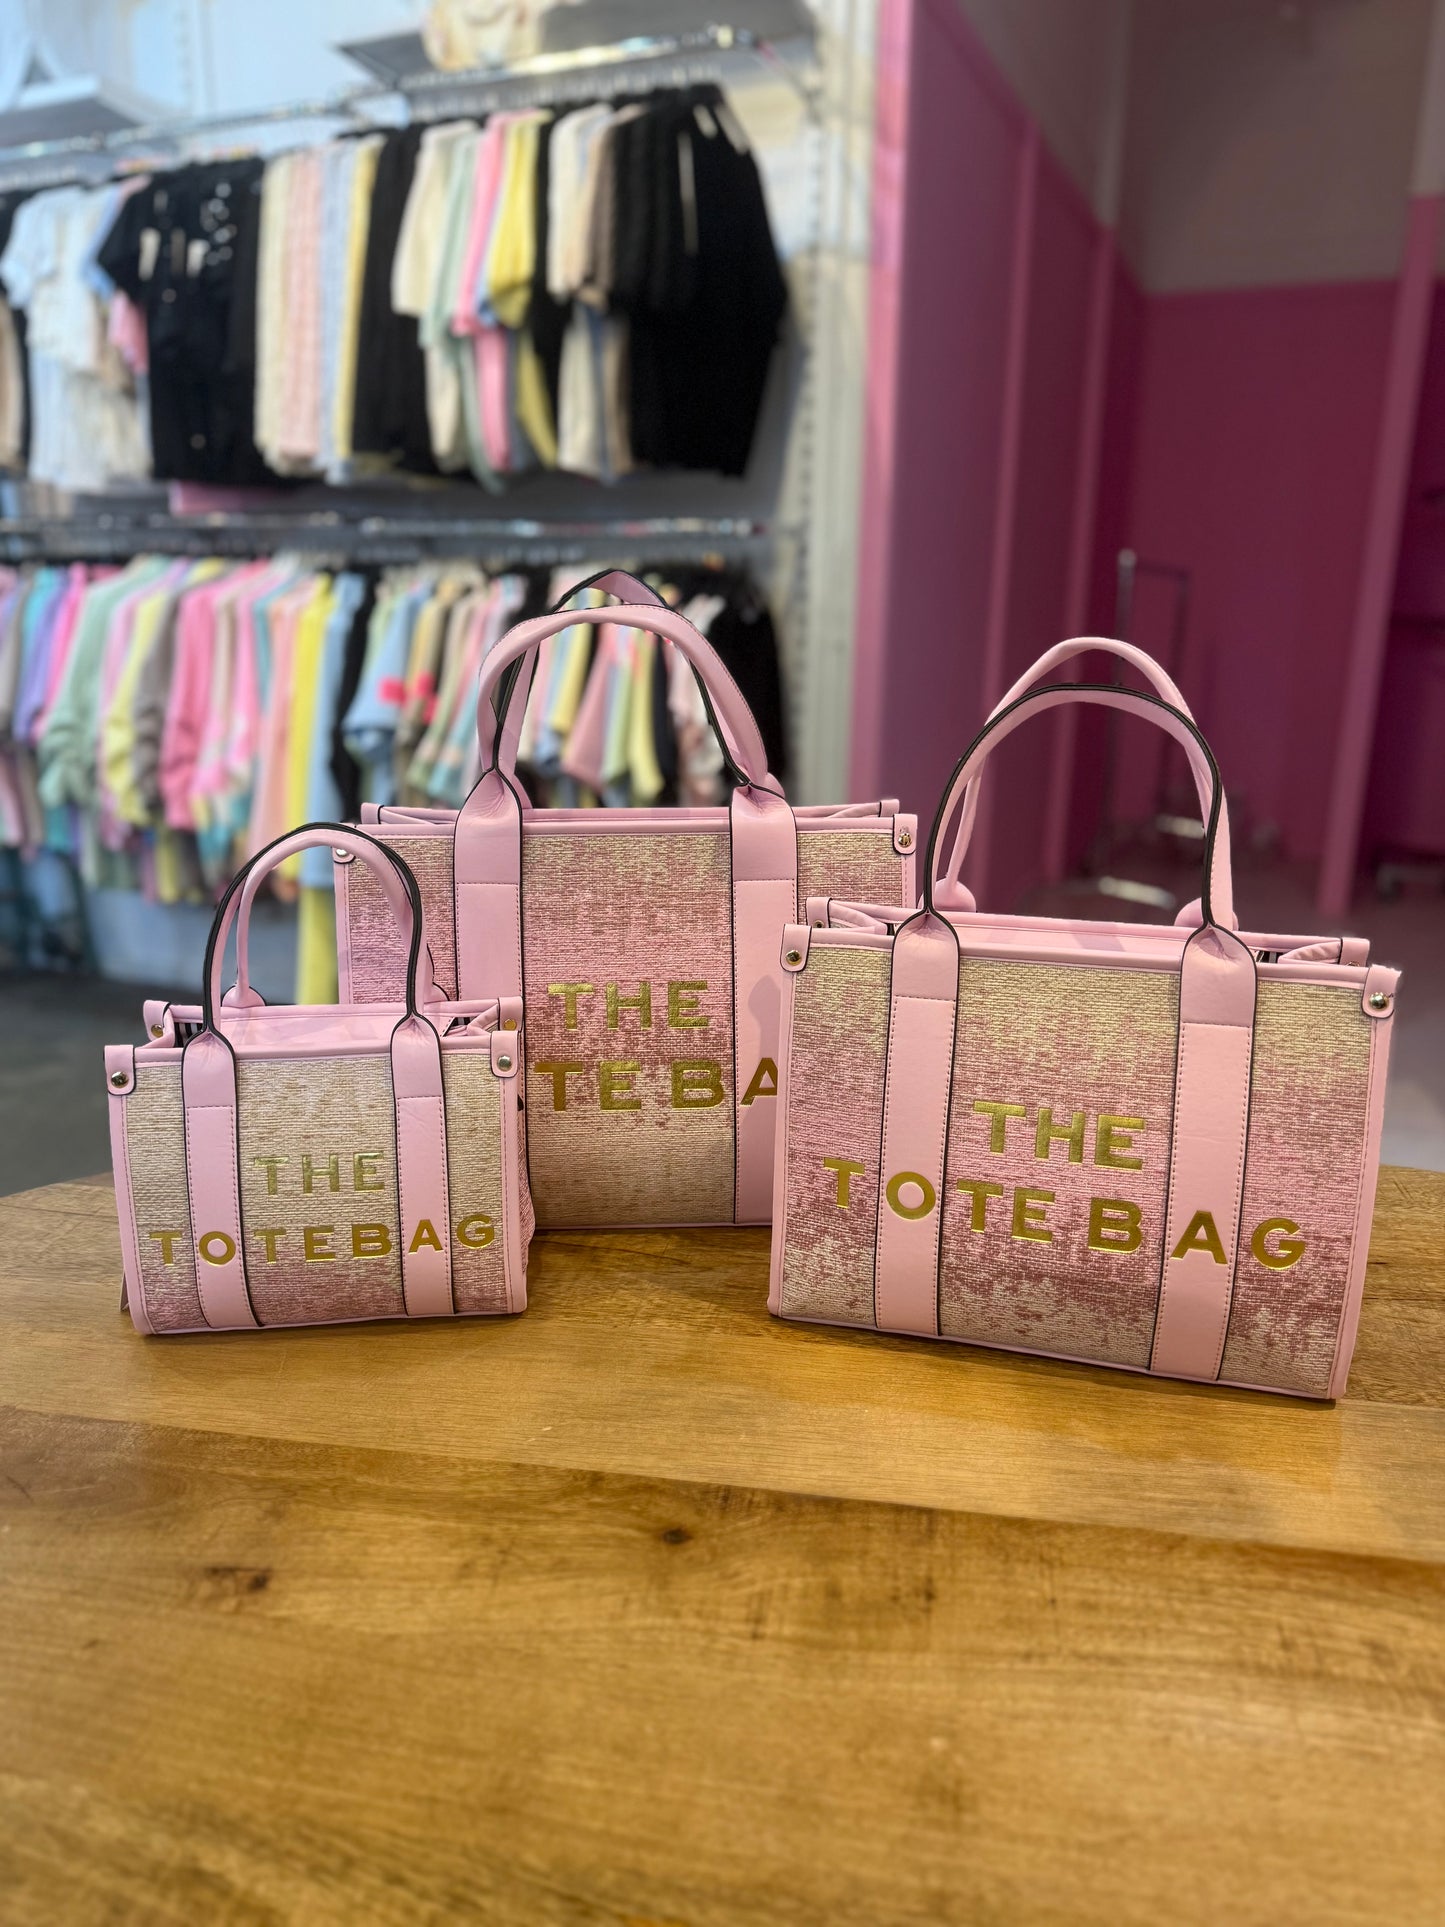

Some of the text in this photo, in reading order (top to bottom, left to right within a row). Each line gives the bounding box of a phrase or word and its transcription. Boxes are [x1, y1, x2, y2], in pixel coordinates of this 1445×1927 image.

[547, 980, 709, 1031] THE
[534, 1057, 779, 1112] TE BA
[973, 1100, 1145, 1171] THE
[253, 1151, 386, 1196] THE
[823, 1157, 1306, 1271] TOTE BAG
